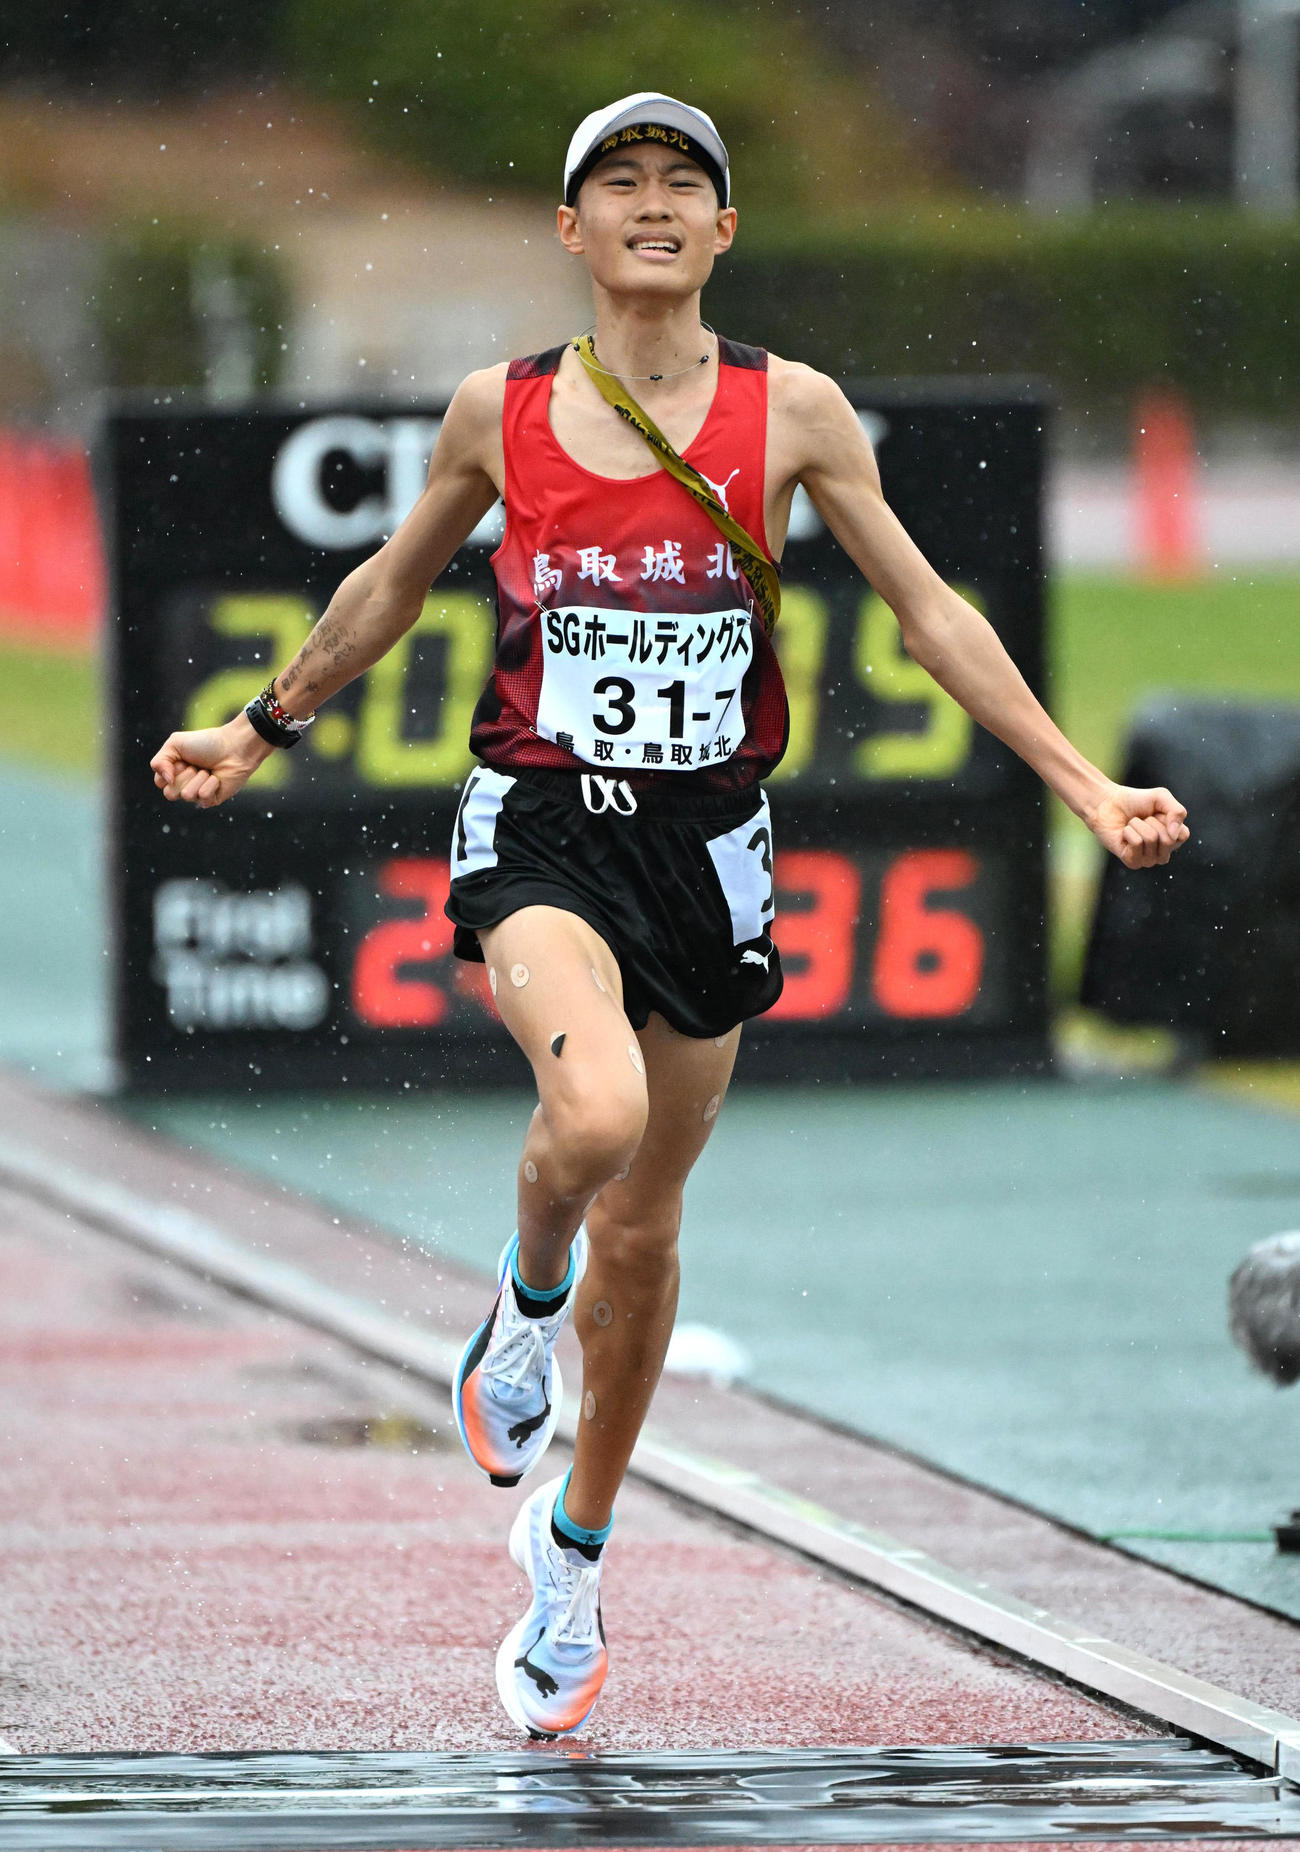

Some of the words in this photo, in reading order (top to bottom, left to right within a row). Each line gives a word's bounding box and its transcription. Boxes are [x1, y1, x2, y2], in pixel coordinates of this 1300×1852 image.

[533, 540, 740, 595] 鳥取城北
[547, 611, 750, 666] SGホールディングス
[592, 676, 737, 739] 31-7
